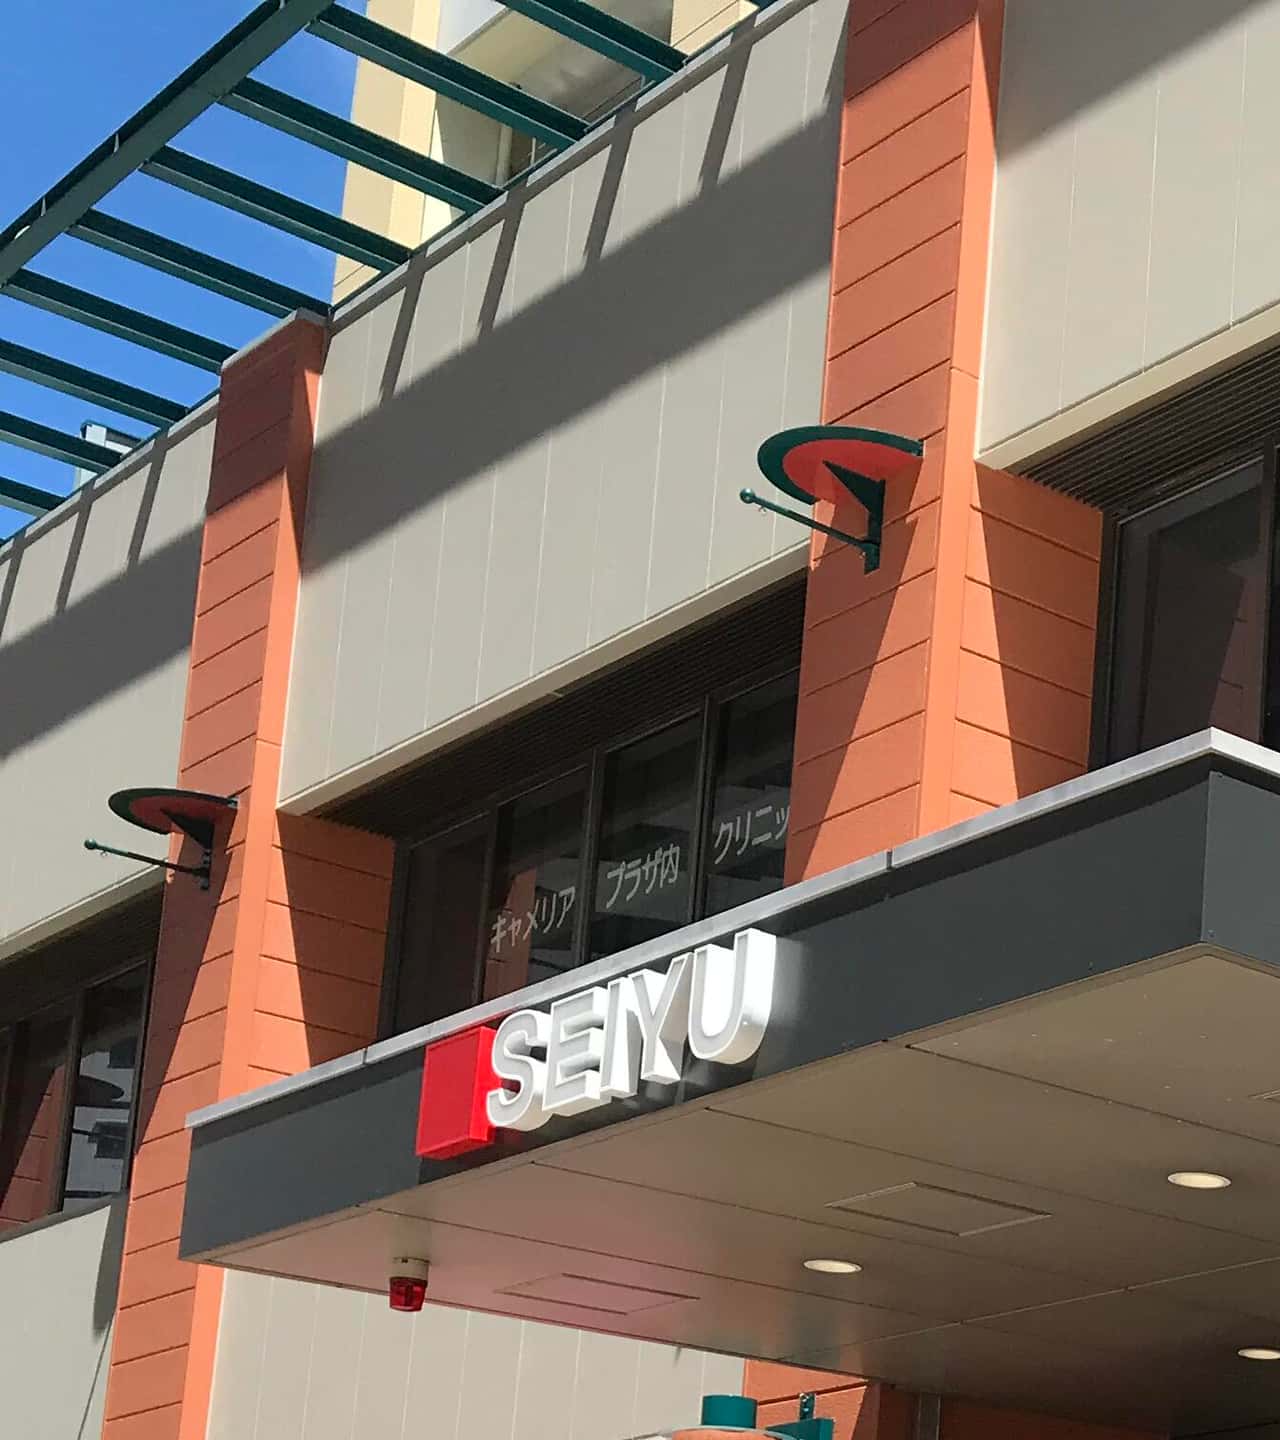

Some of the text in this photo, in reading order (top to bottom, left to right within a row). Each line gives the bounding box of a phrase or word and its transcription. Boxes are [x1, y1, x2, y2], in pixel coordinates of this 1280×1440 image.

[490, 886, 576, 953] キャメリア
[606, 843, 681, 909] プラザ内
[487, 928, 777, 1131] SEIYU
